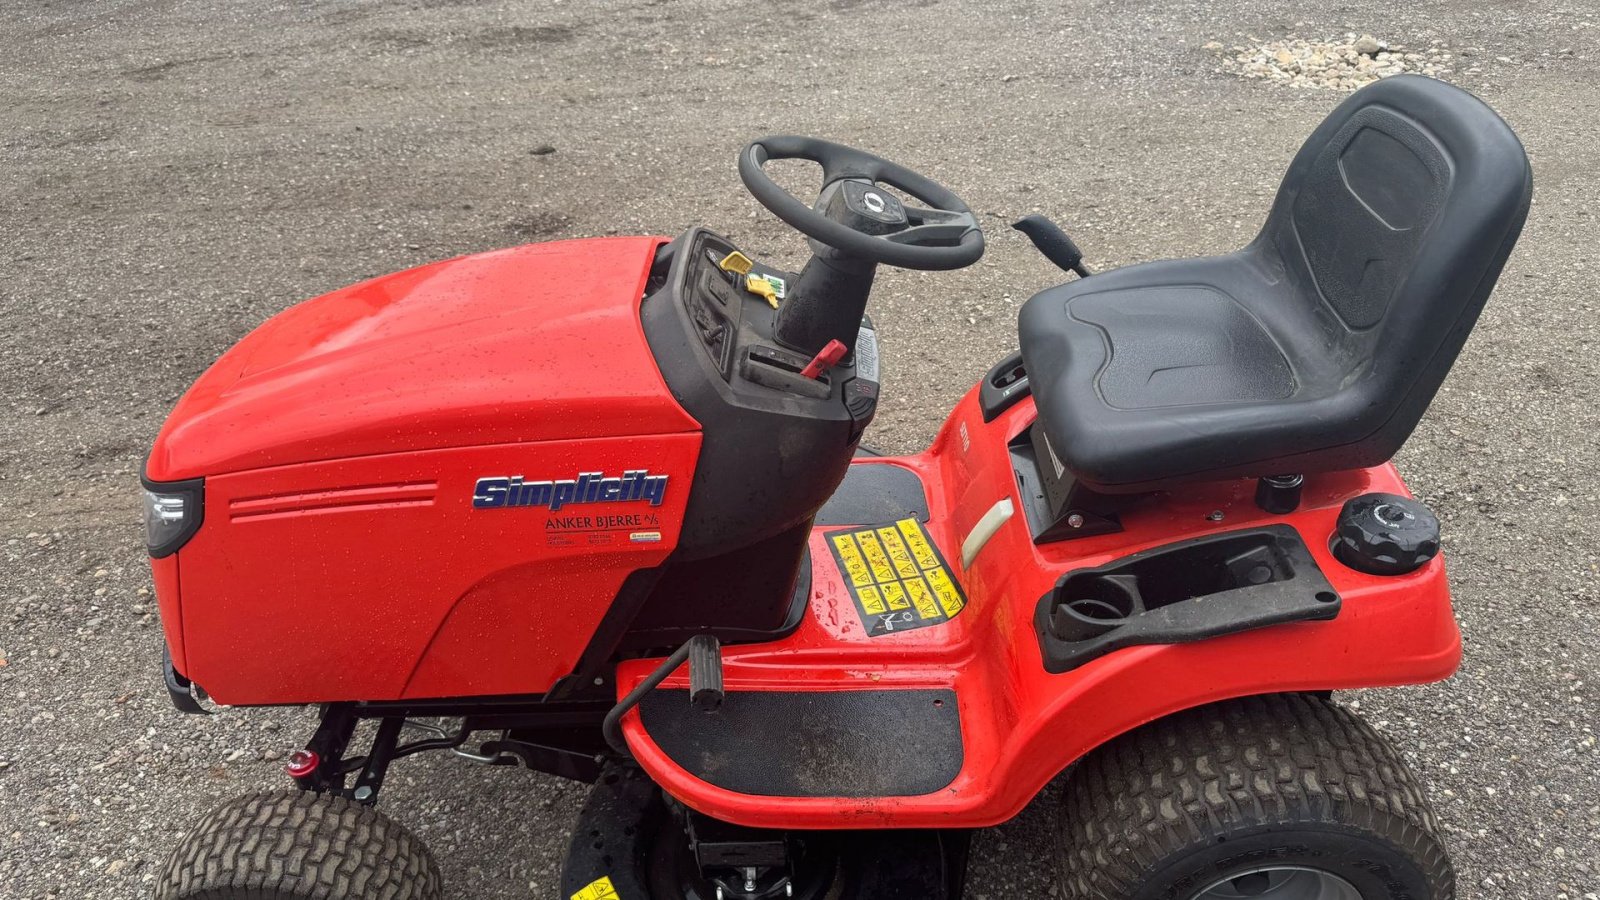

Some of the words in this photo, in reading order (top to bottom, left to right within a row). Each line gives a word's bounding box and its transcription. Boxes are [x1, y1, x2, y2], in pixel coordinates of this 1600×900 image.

[472, 469, 669, 511] Simplicity
[545, 517, 593, 530] ANKER
[596, 514, 642, 528] BJERRE
